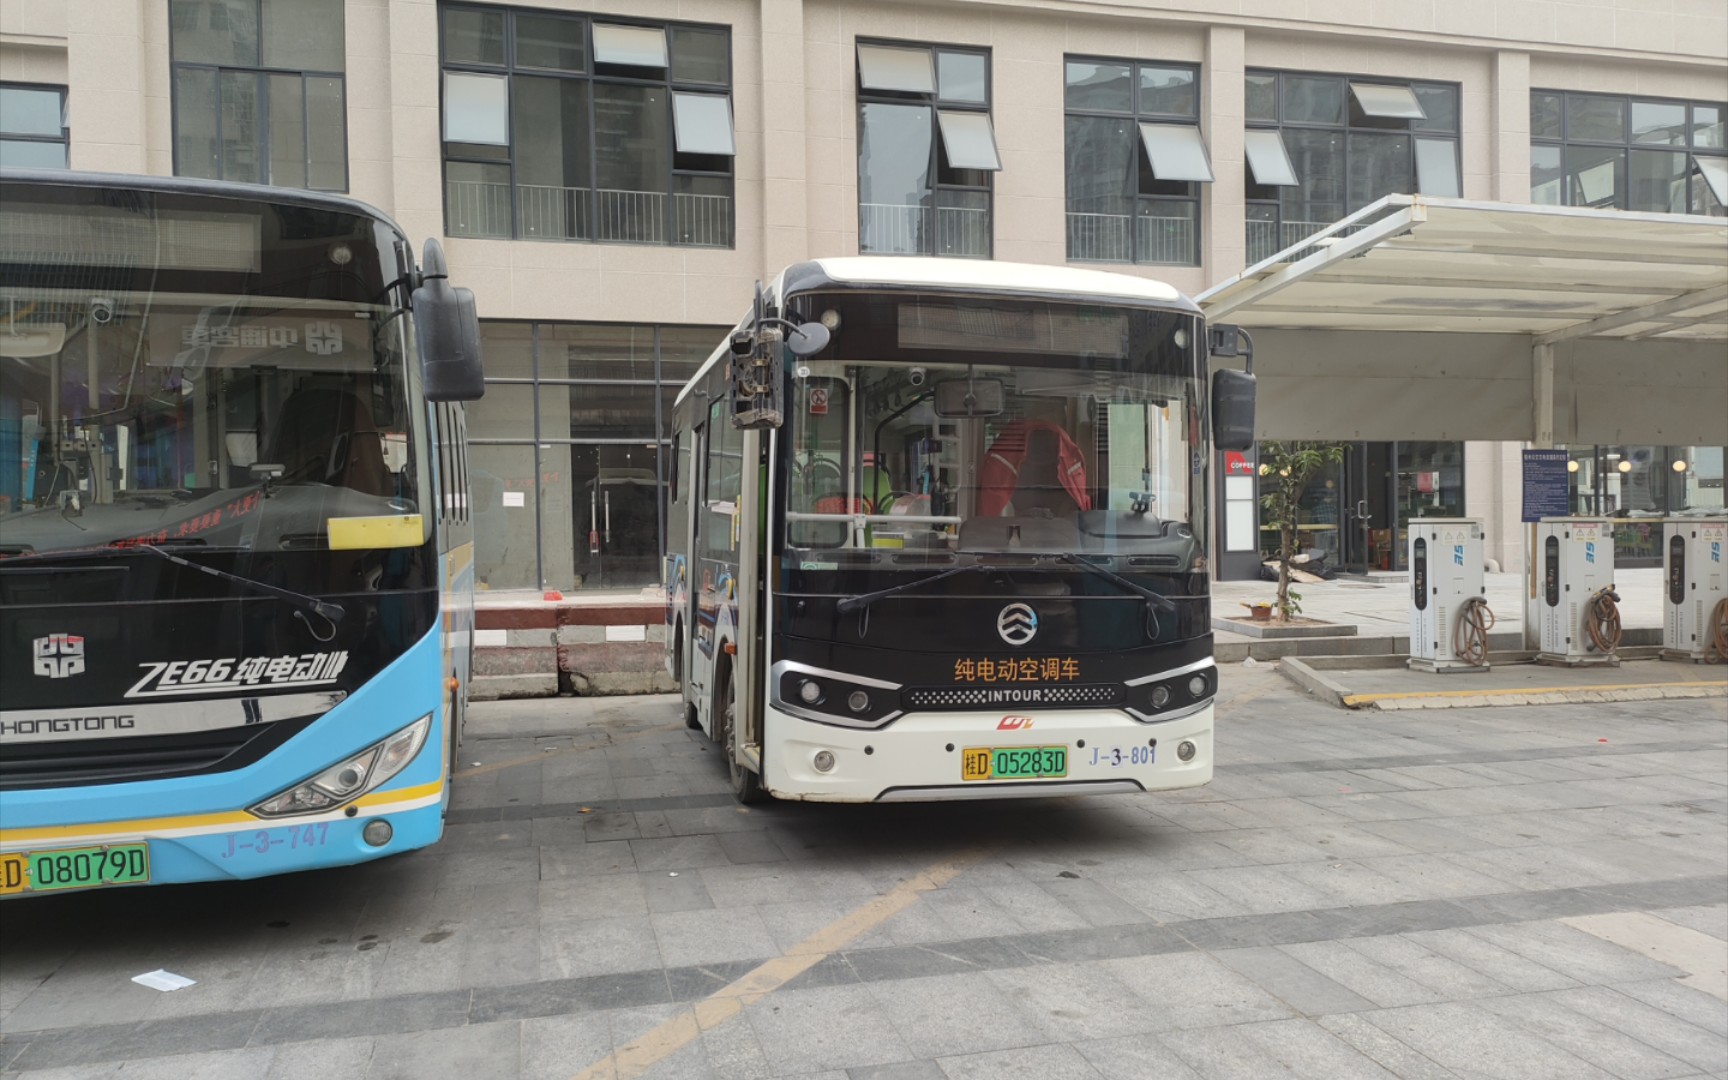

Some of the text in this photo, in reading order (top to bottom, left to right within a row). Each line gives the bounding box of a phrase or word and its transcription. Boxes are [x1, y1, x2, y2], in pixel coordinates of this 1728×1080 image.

[124, 652, 334, 698] ZE66 纯电动
[954, 657, 1080, 682] 纯电动空调车
[988, 689, 1042, 702] INTOUR
[1089, 746, 1156, 766] J-3-801
[220, 822, 329, 859] J-3-747
